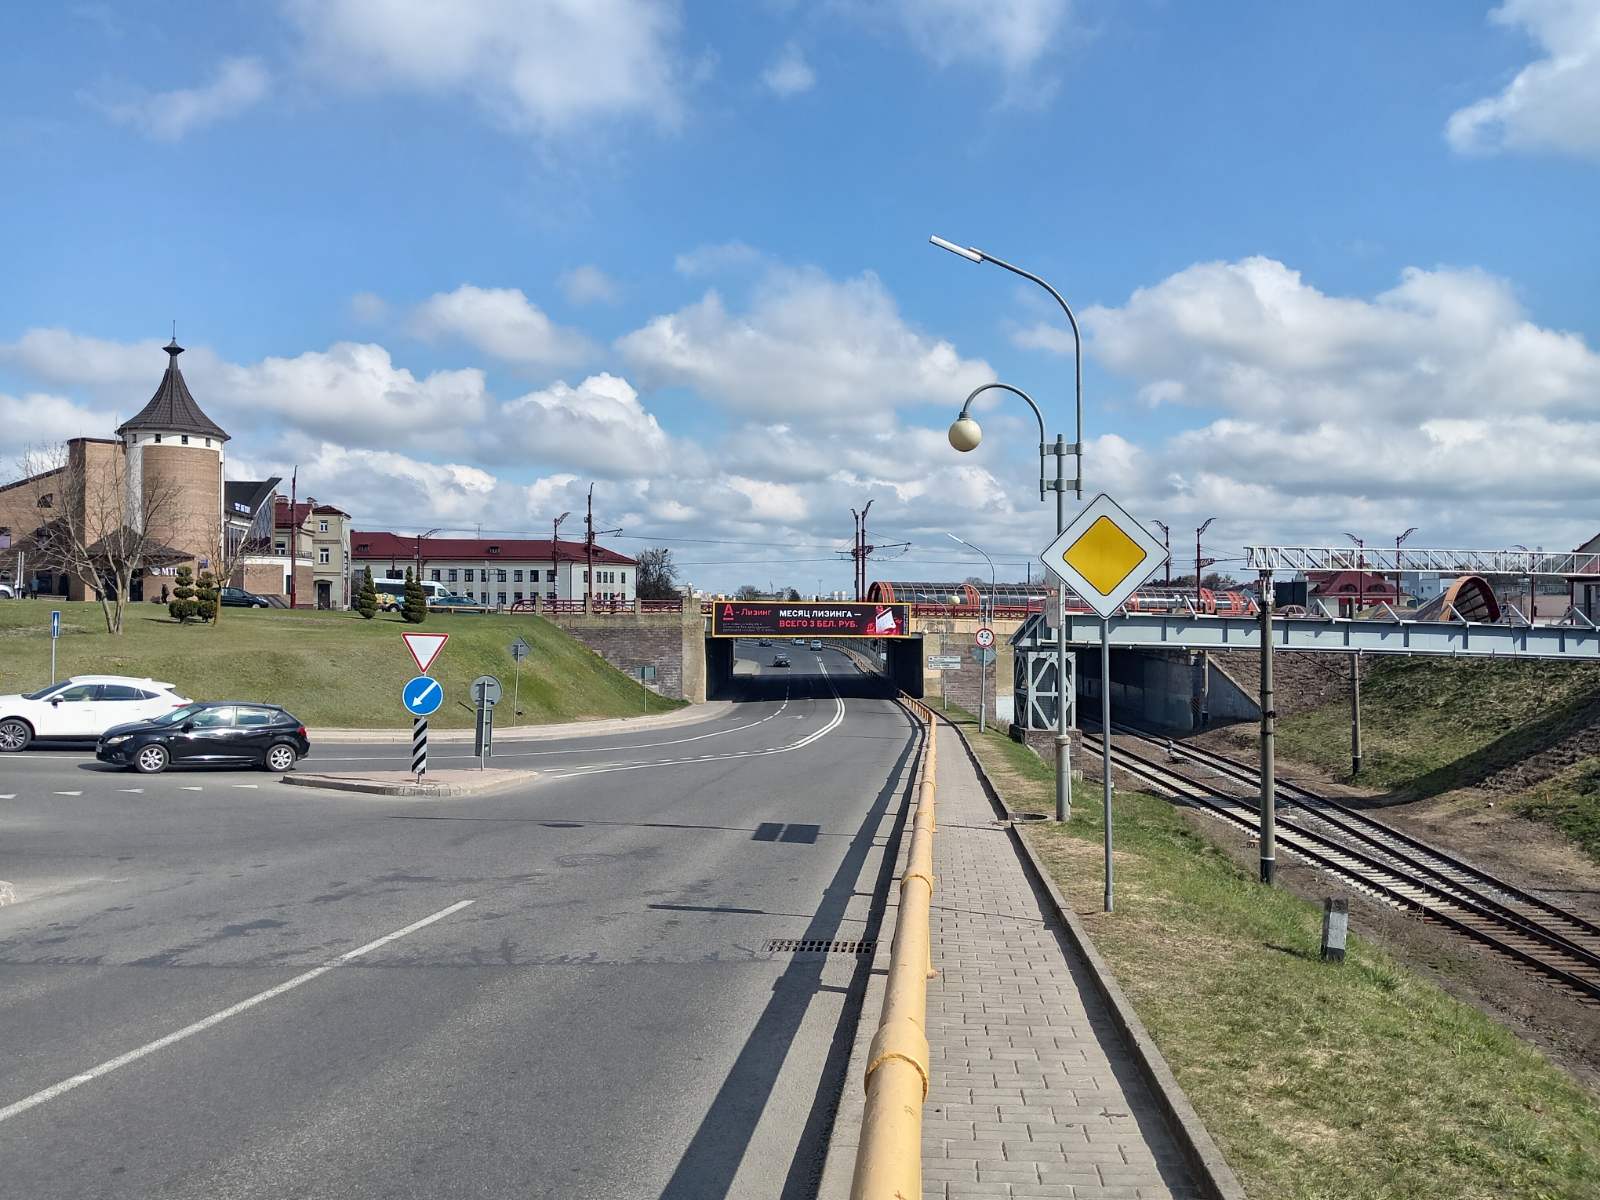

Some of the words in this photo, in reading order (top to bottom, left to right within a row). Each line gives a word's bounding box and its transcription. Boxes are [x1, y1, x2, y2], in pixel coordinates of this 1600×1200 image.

[779, 610, 811, 619] МЕСЯЦ
[812, 610, 853, 618] ЛИЗИНГА
[779, 619, 808, 628] ВСЕГО
